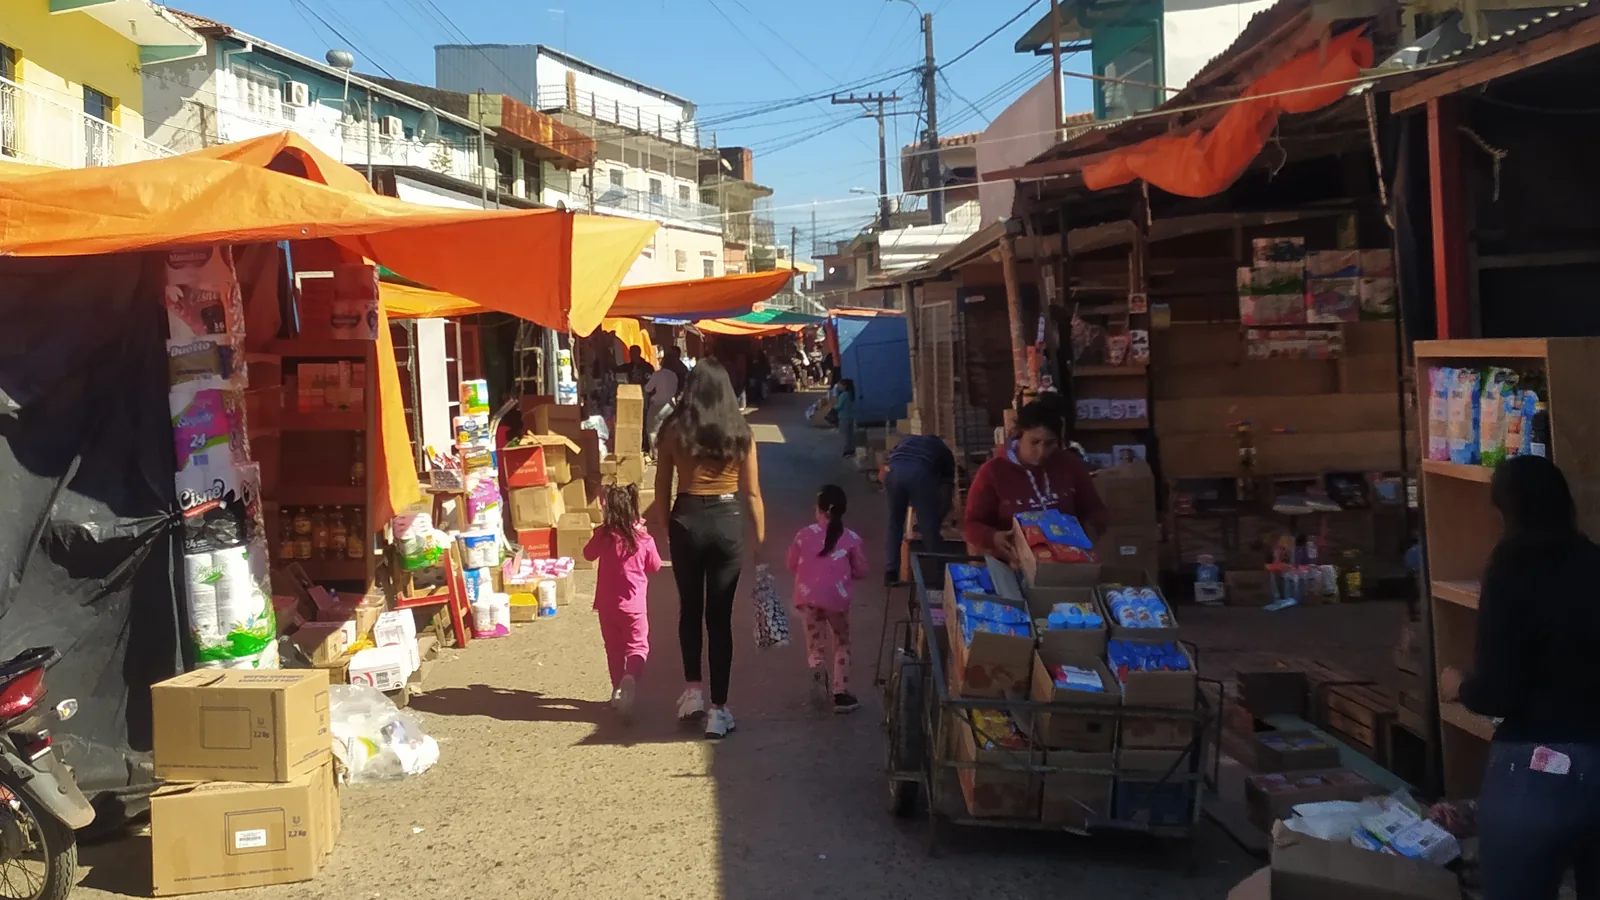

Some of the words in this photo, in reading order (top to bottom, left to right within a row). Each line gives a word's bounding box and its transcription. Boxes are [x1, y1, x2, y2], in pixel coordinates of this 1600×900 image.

[190, 433, 207, 448] 24
[179, 479, 225, 511] Cisne
[475, 501, 486, 511] 24
